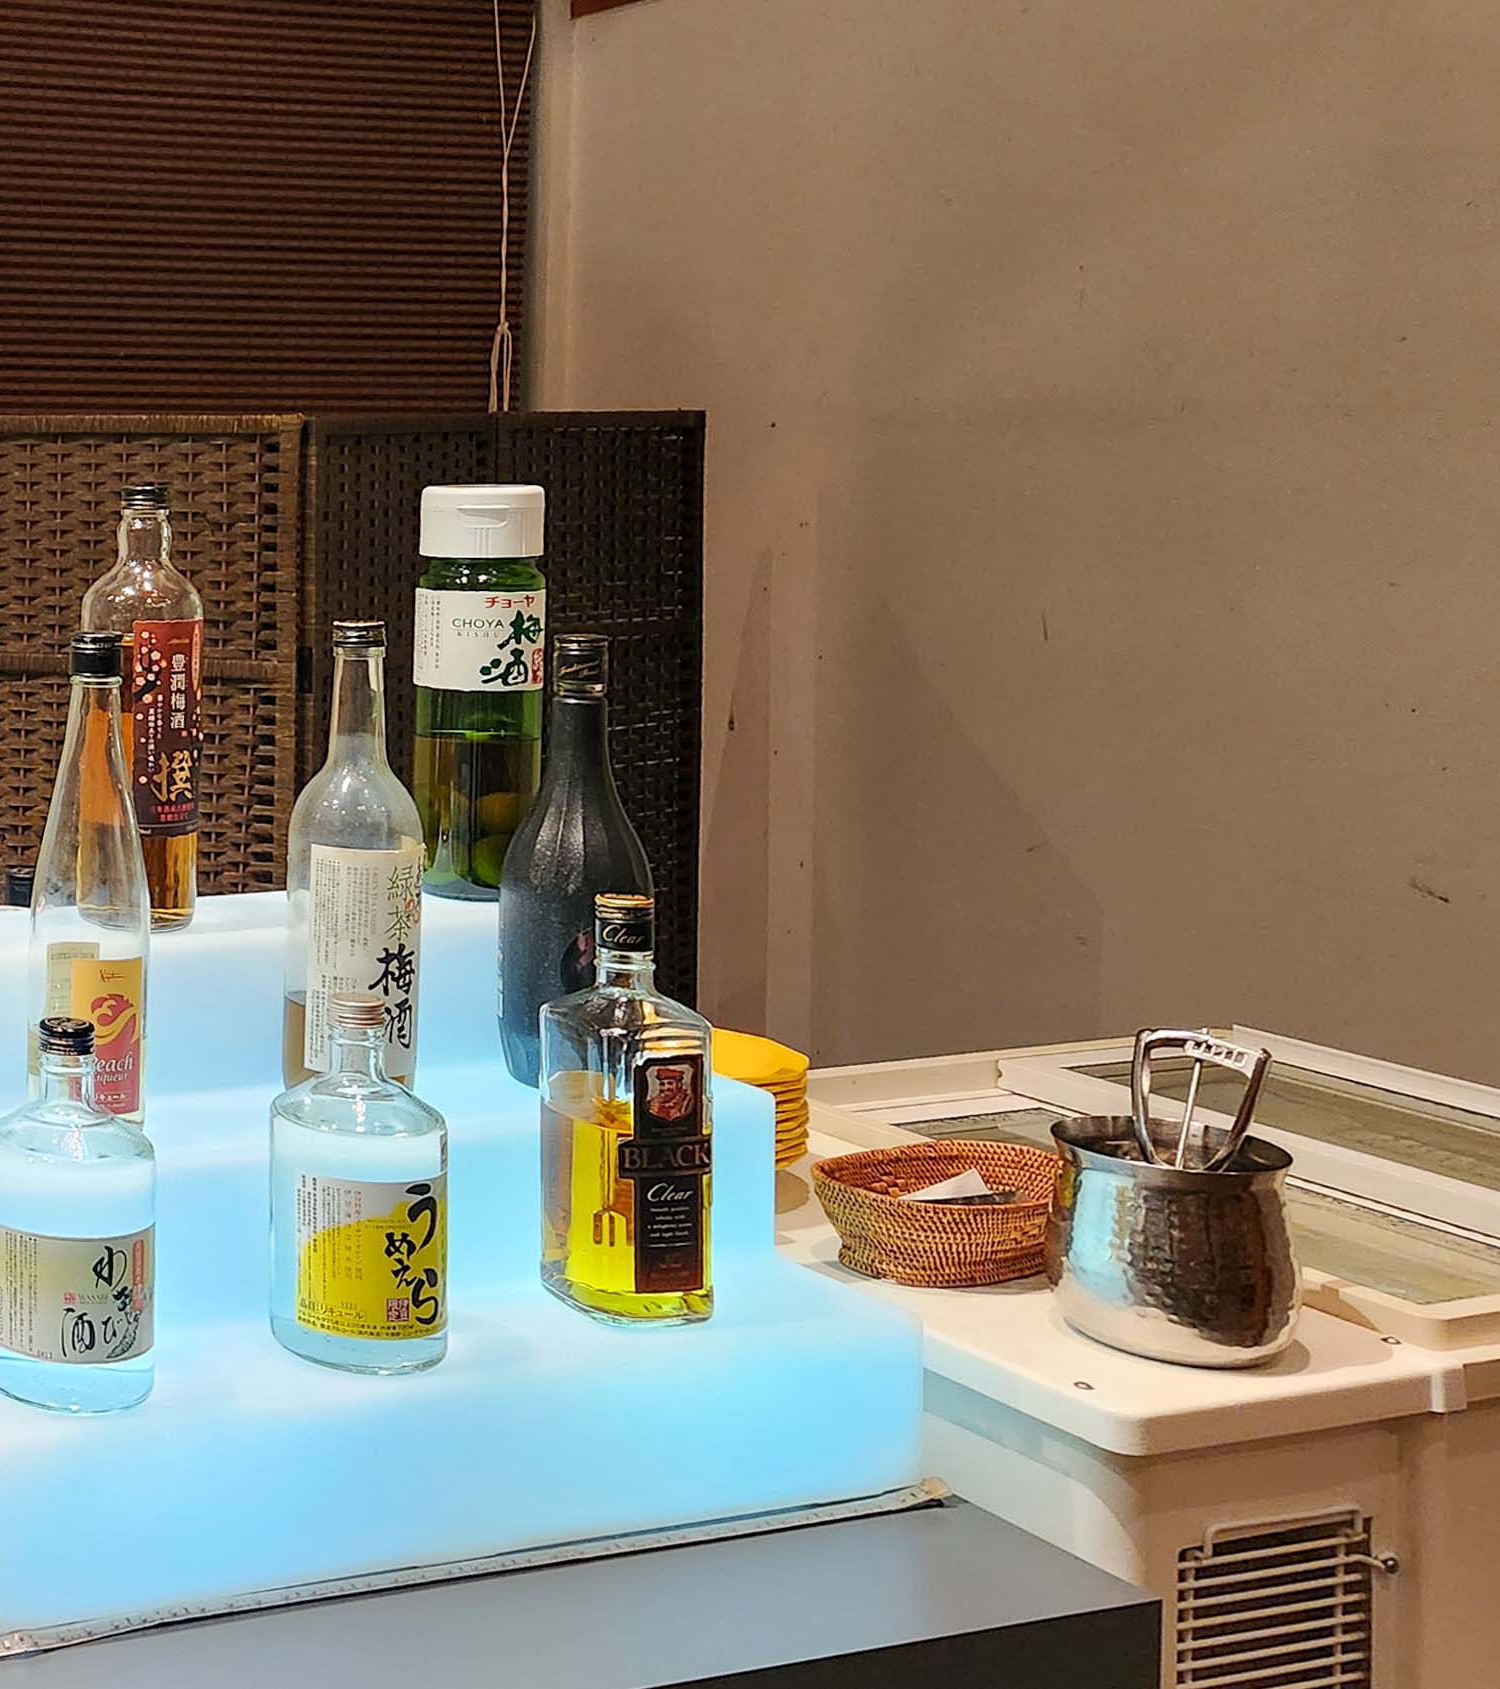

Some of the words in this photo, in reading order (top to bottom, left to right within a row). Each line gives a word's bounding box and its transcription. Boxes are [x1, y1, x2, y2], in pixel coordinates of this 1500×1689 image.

[484, 594, 535, 609] チョーヤ
[451, 617, 505, 629] CHOYA
[478, 609, 544, 686] 梅酒
[601, 924, 645, 945] Clear
[623, 1143, 711, 1170] BLACK
[647, 1182, 693, 1202] Clear
